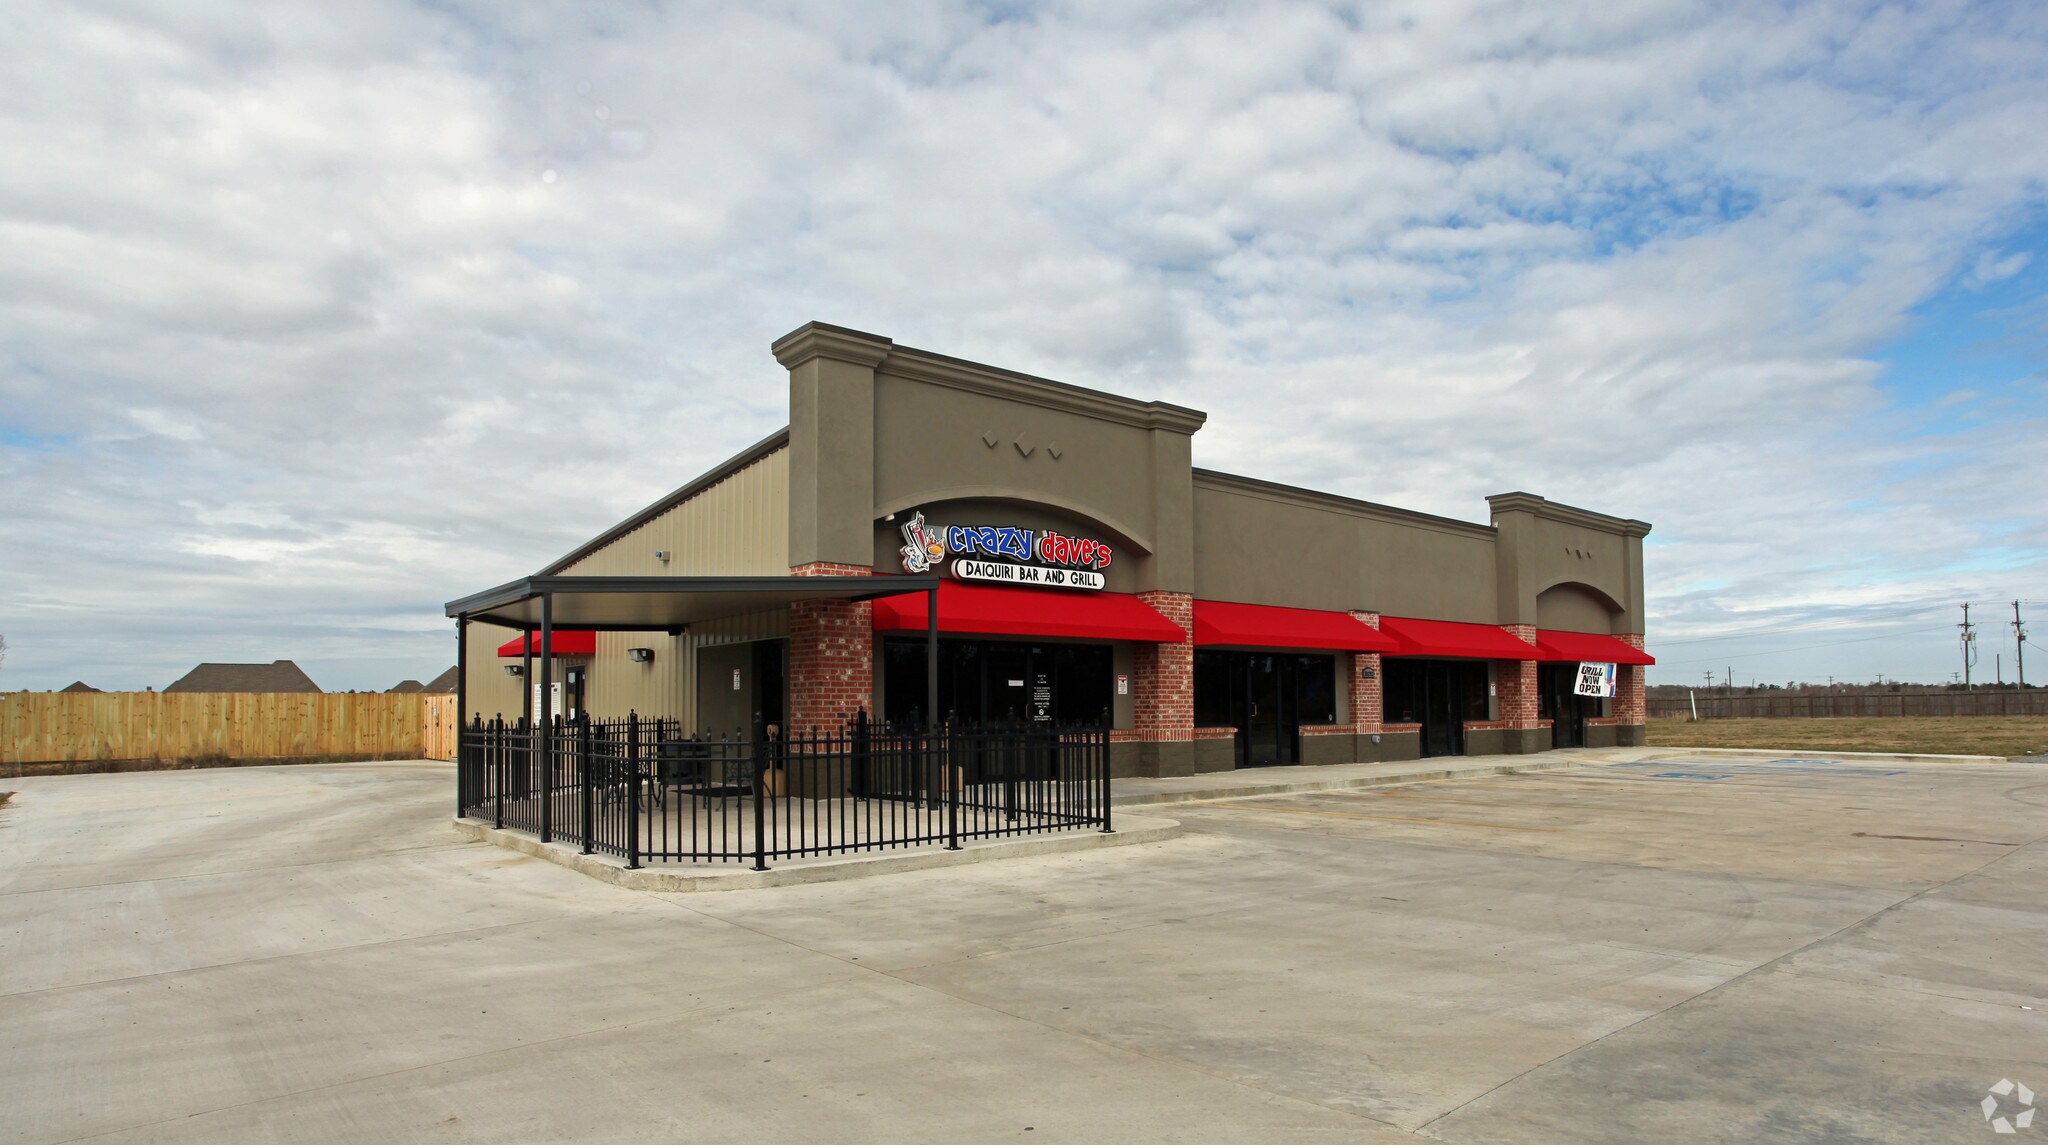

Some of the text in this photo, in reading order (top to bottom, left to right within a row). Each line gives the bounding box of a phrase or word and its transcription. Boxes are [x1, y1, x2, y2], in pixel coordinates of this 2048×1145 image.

[949, 526, 1034, 560] crazy
[966, 561, 1097, 586] DAIQUIRI BAR AND GRILL
[1581, 666, 1603, 676] GRILL
[1582, 675, 1600, 685] NOW
[1579, 684, 1601, 694] OPEN
